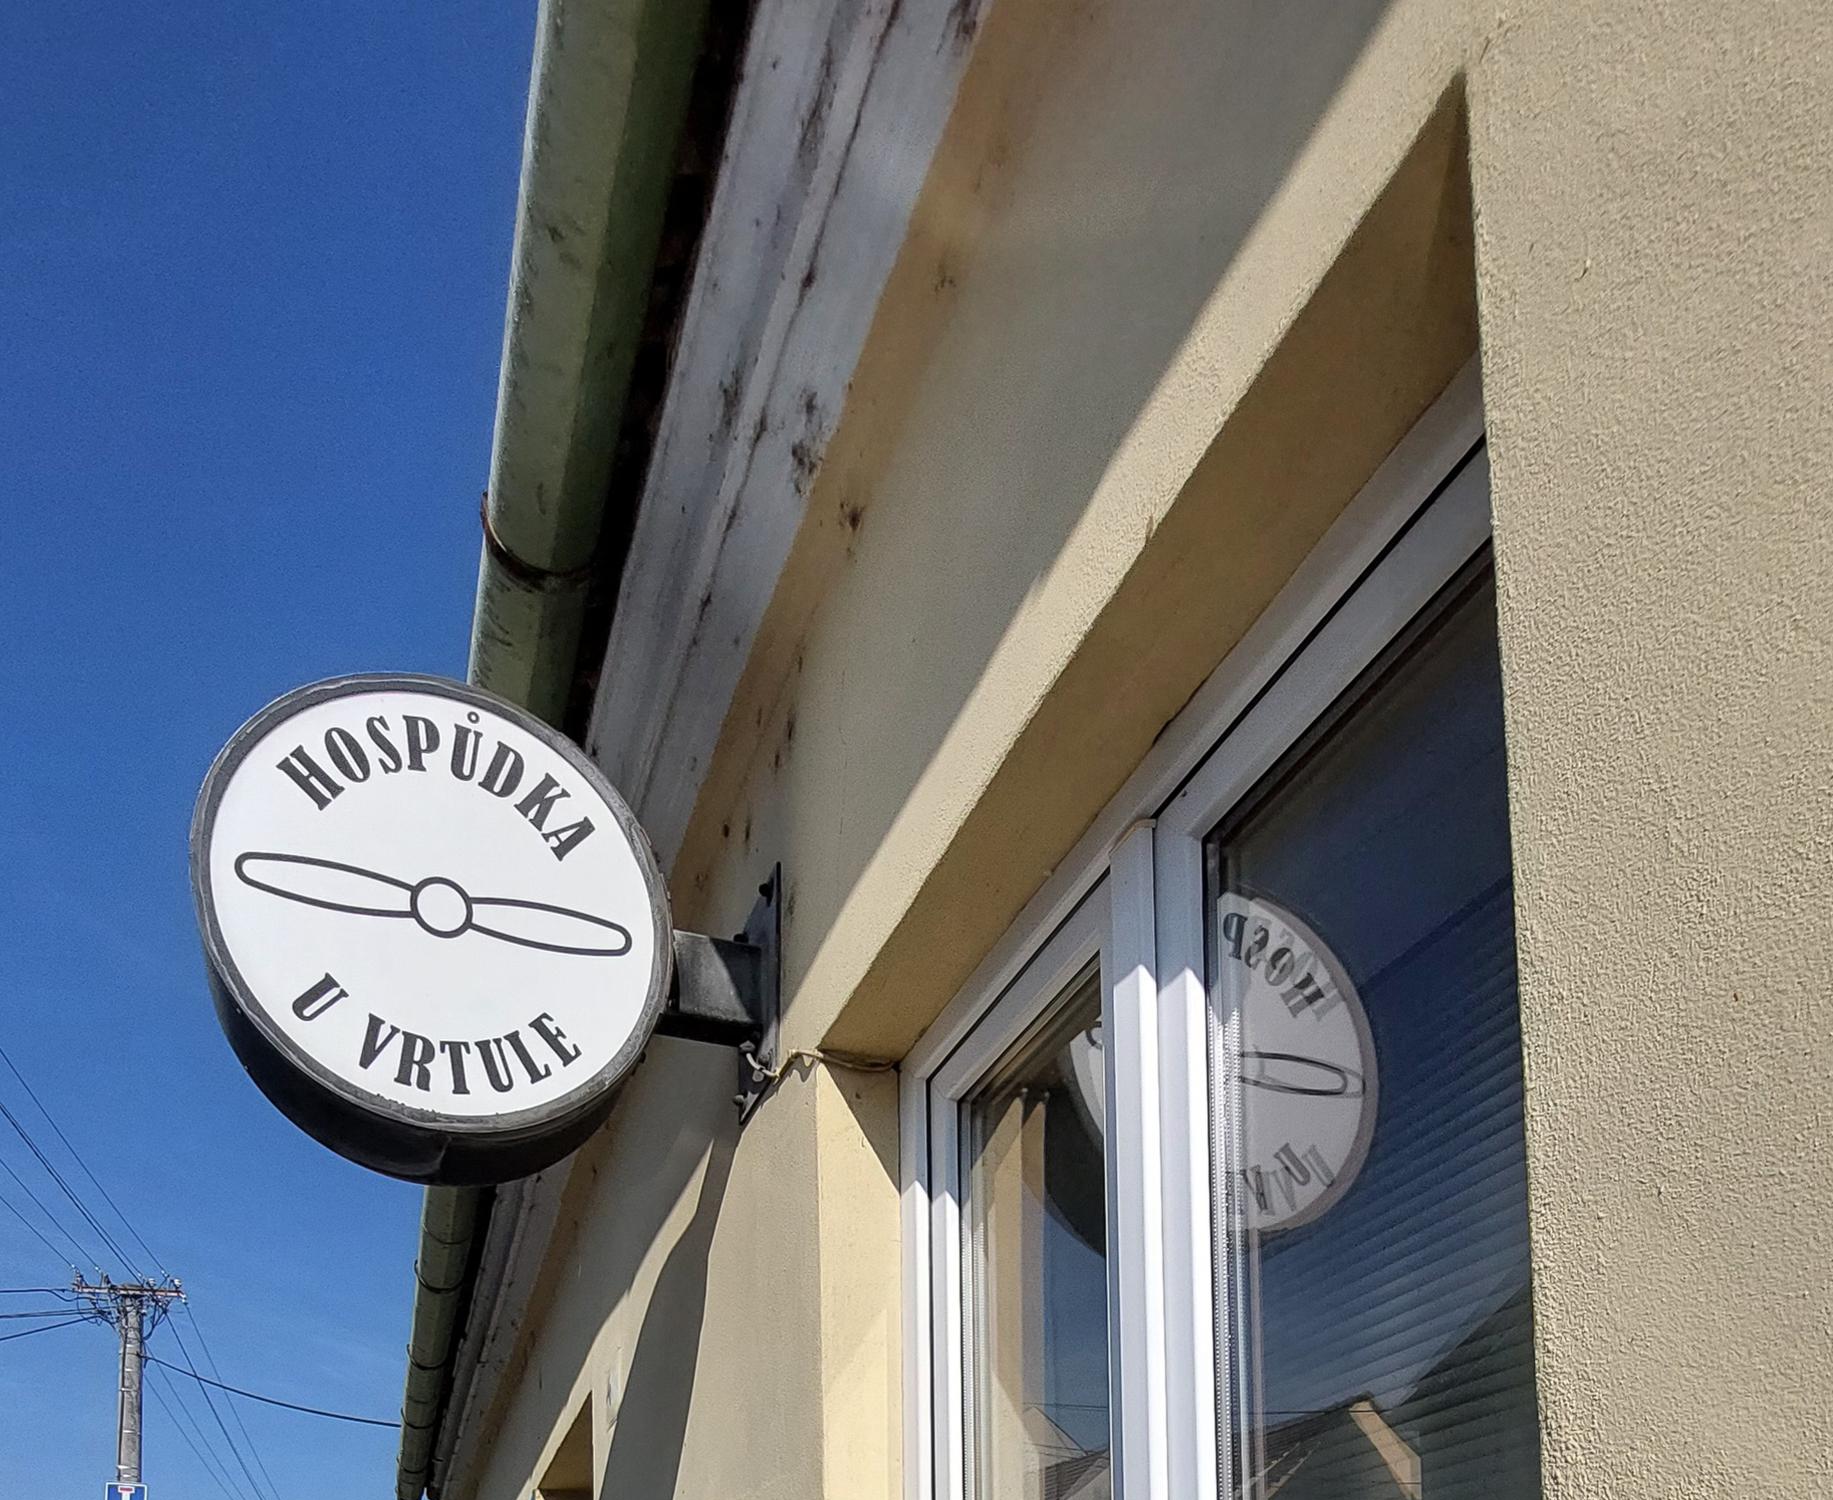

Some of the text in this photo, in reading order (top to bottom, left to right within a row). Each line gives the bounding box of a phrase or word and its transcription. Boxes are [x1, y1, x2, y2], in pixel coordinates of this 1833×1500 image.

[276, 711, 596, 862] HOSPŮDKA
[291, 972, 583, 1096] U VRTULE
